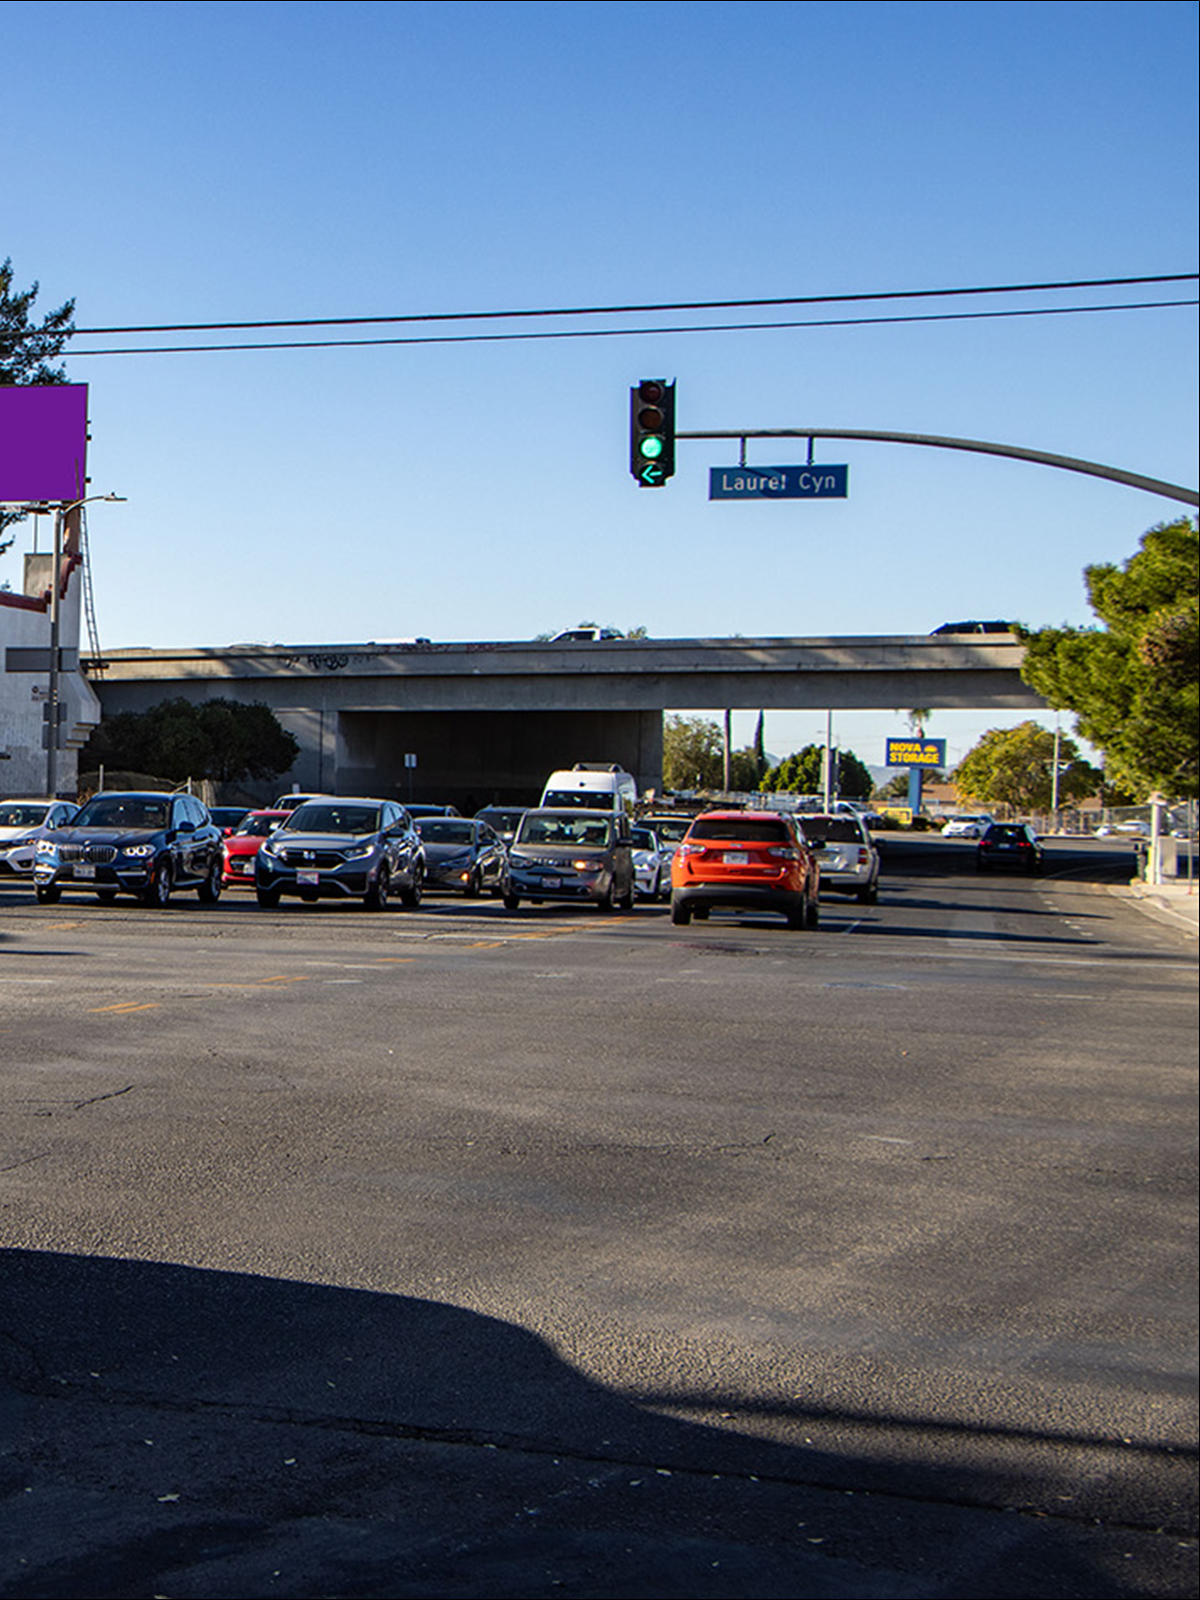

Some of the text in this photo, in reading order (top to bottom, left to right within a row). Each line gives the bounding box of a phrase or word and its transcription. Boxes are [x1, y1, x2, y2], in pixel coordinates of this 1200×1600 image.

[722, 472, 835, 493] Laurel Cyn
[889, 742, 921, 752] NOVA
[889, 751, 940, 764] STORAGE
